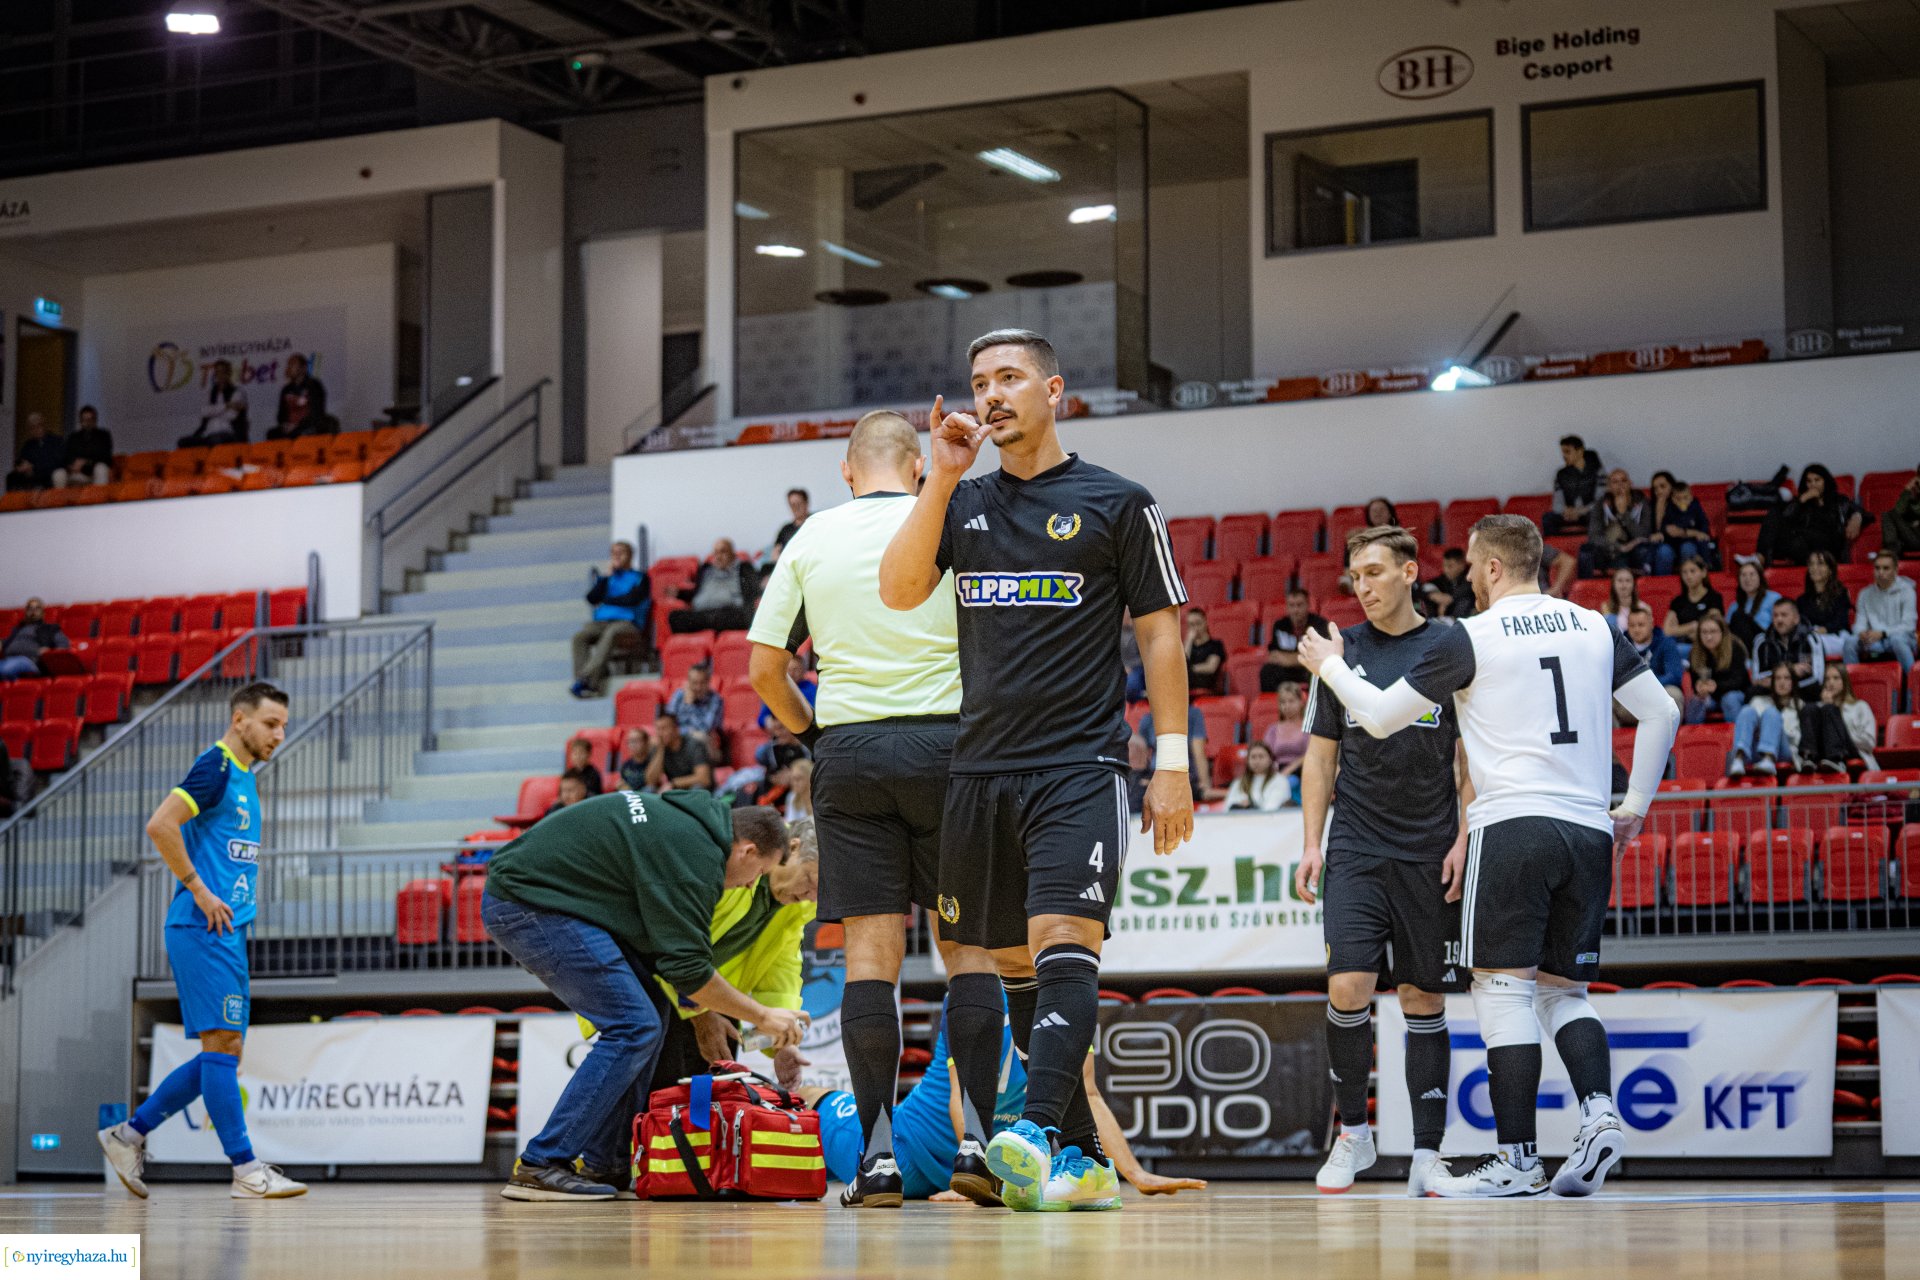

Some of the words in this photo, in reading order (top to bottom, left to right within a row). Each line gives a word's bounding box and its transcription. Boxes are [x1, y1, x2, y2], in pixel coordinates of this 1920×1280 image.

[1496, 37, 1545, 57] Bige
[1553, 27, 1641, 50] Holding
[1397, 54, 1455, 92] BH
[1523, 54, 1613, 80] Csoport
[1500, 609, 1567, 636] FARAGÓ
[1569, 608, 1588, 632] Á.
[1539, 656, 1579, 745] 1
[1088, 841, 1104, 873] 4
[1230, 909, 1323, 929] Szövetsé
[1444, 941, 1460, 965] 19
[1094, 1019, 1272, 1093] 90
[258, 1074, 465, 1110] NYÍREGYHÁZA
[1704, 1085, 1795, 1130] KFT
